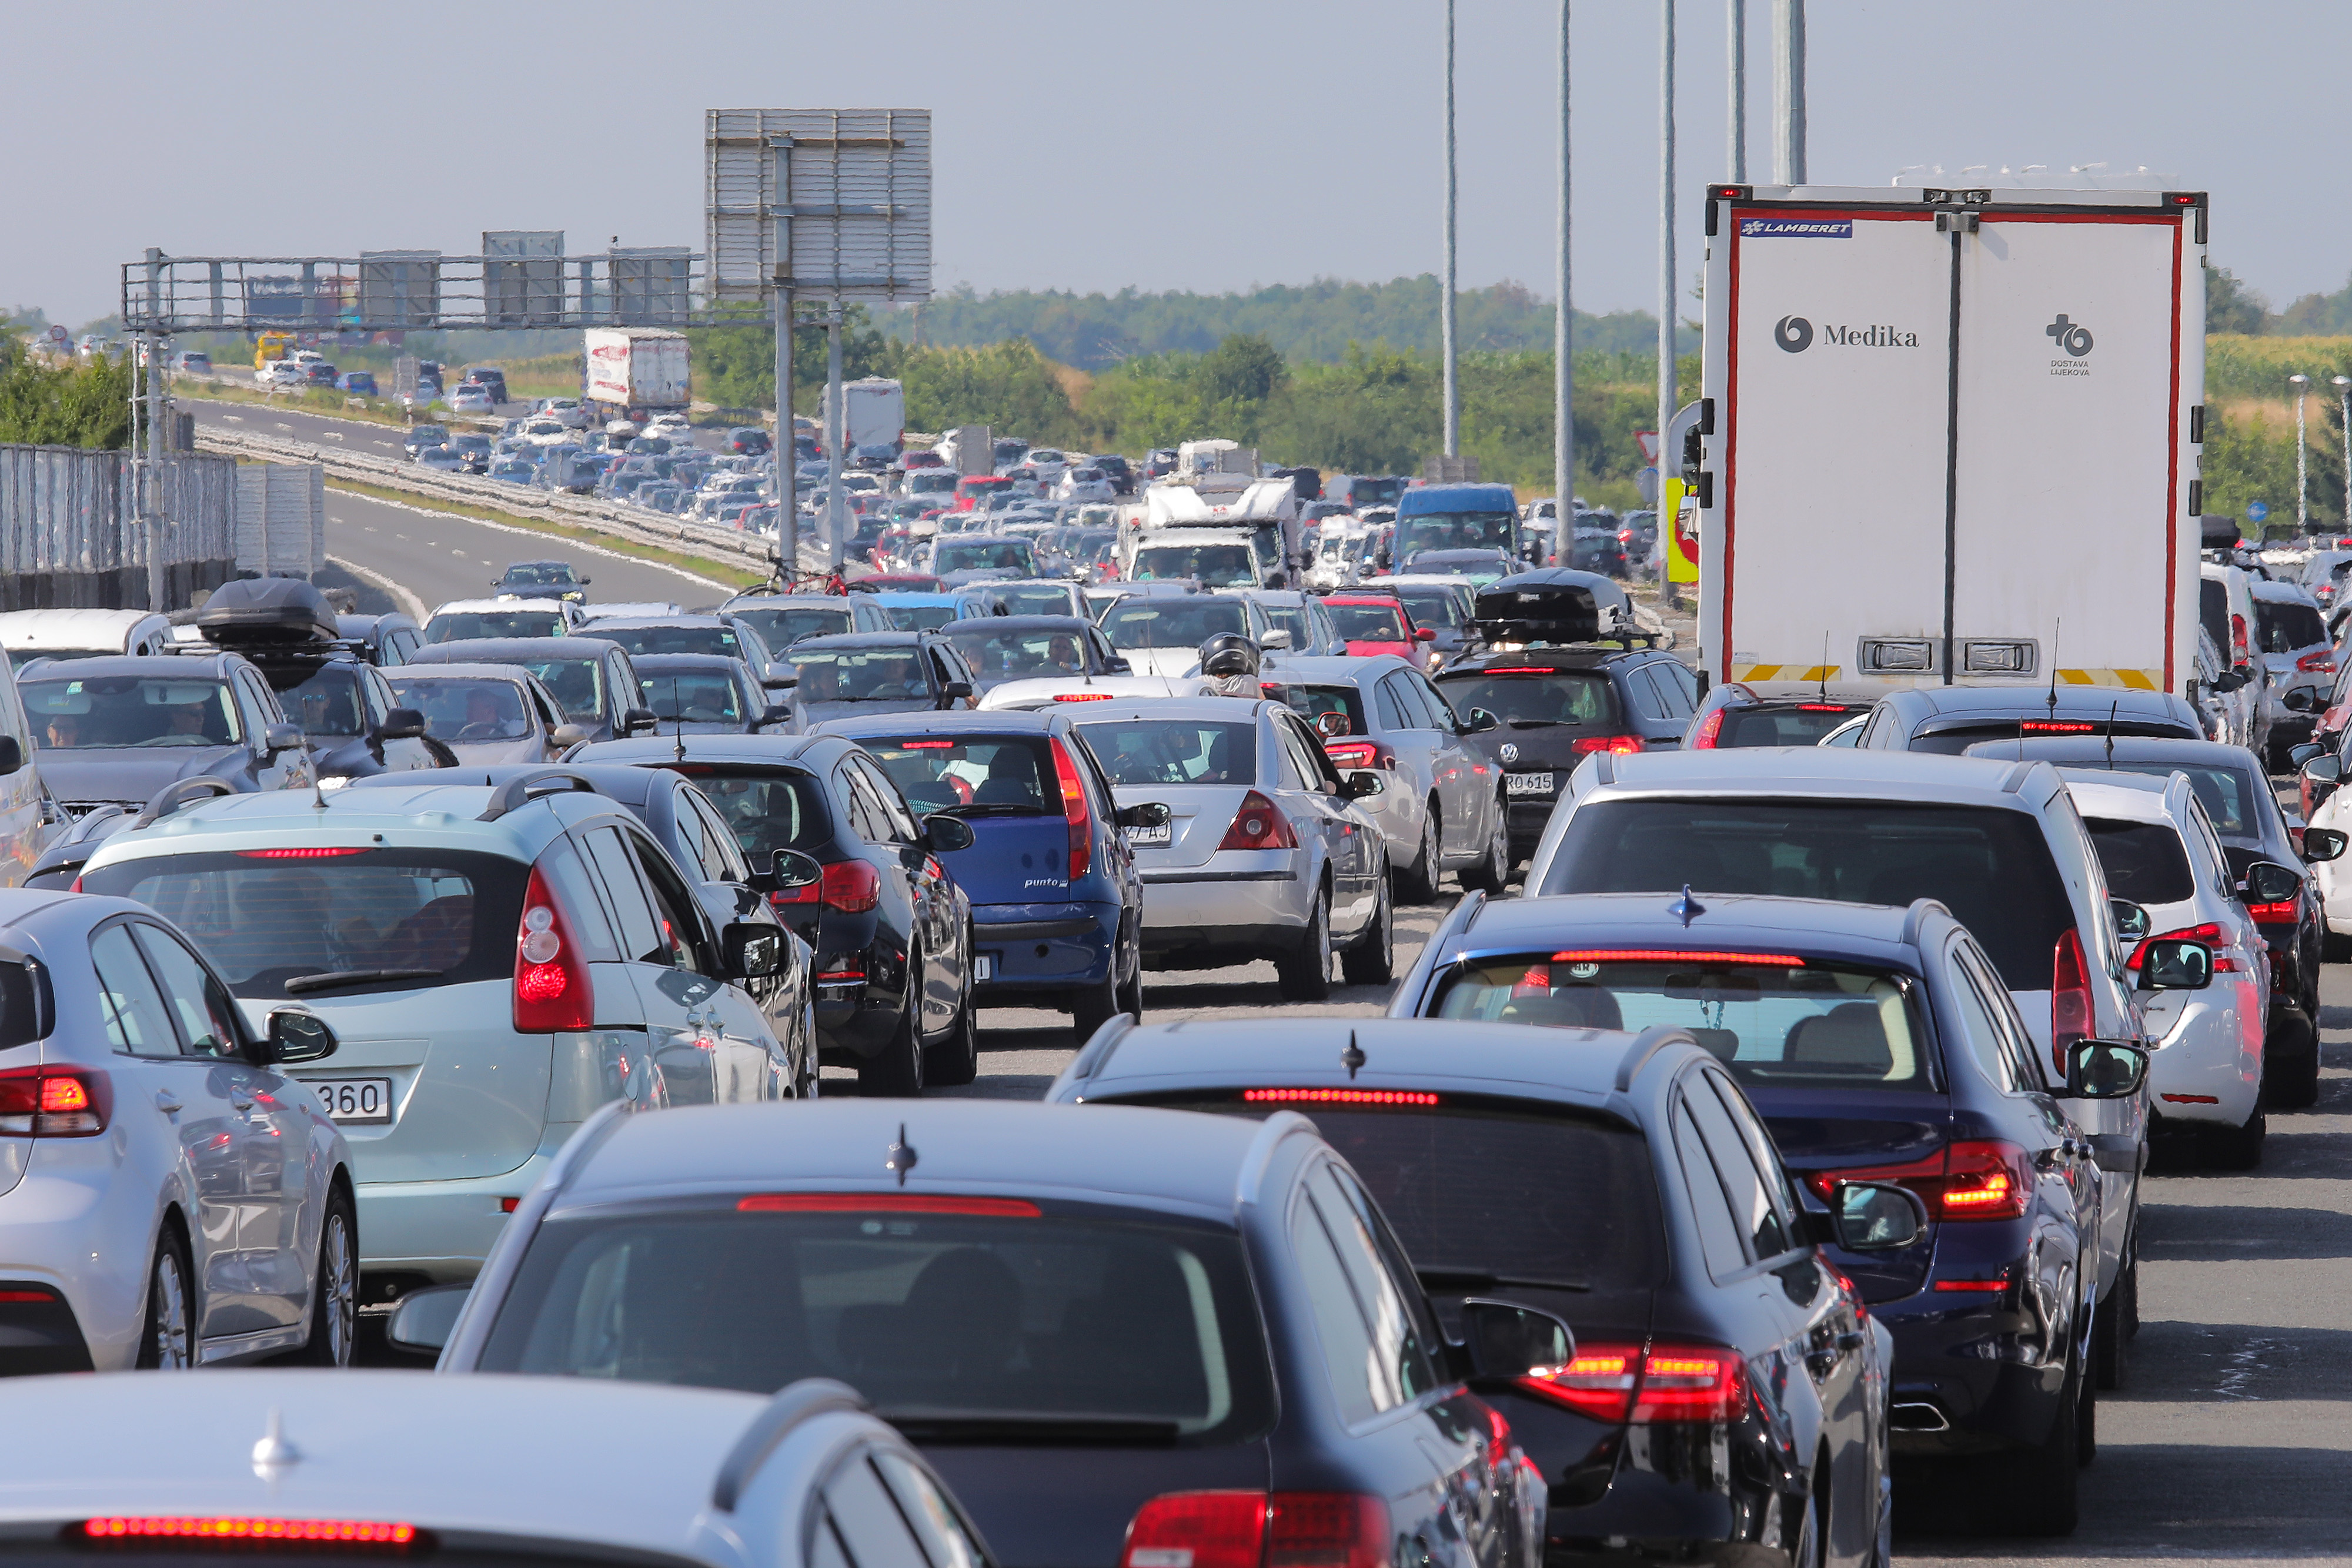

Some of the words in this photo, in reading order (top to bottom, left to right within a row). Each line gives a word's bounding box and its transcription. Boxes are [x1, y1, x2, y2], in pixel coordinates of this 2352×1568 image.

[1765, 223, 1851, 233] LAMBERET
[1824, 325, 1920, 347] Medika
[1527, 774, 1551, 788] 615
[1024, 878, 1058, 889] punto
[318, 1085, 378, 1114] 360
